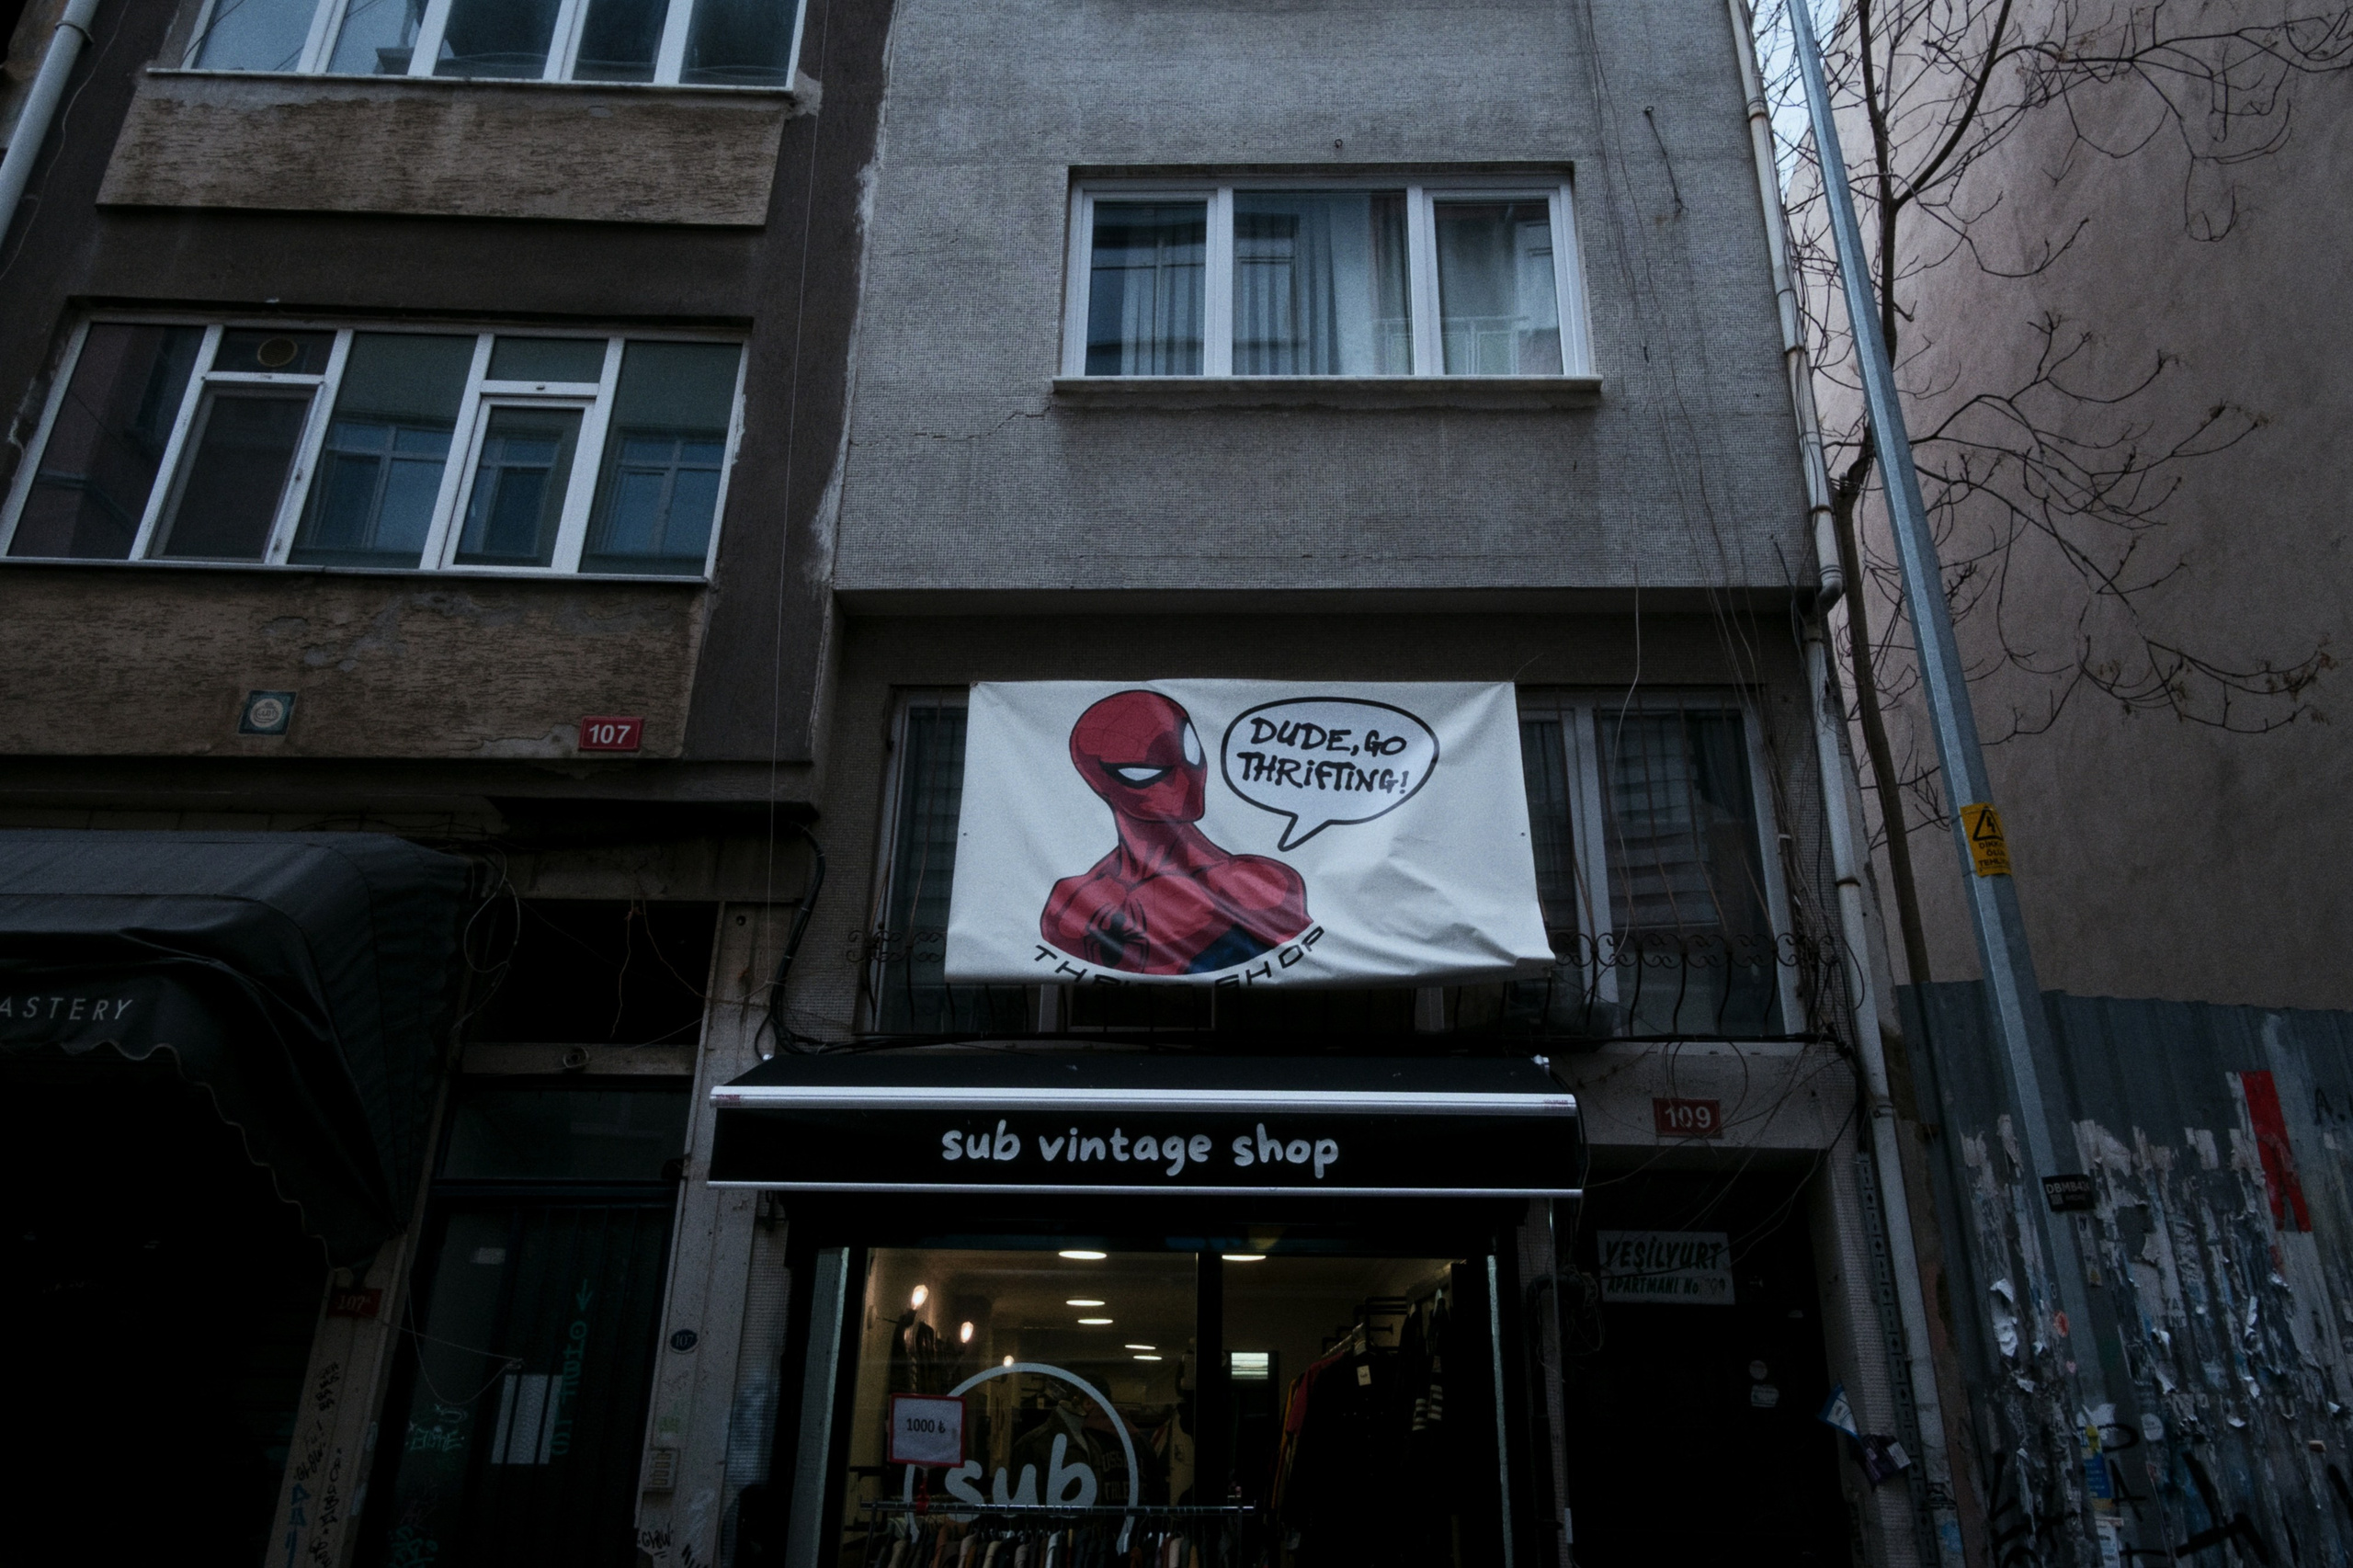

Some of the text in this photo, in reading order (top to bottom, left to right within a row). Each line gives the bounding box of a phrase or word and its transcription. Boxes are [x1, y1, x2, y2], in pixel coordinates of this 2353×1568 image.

[589, 724, 631, 744] 107
[1665, 1106, 1711, 1129] 109
[941, 1119, 1339, 1180] sub vintage shop
[676, 1335, 694, 1347] 107
[906, 1418, 935, 1433] 1000
[945, 1432, 1099, 1522] sub
